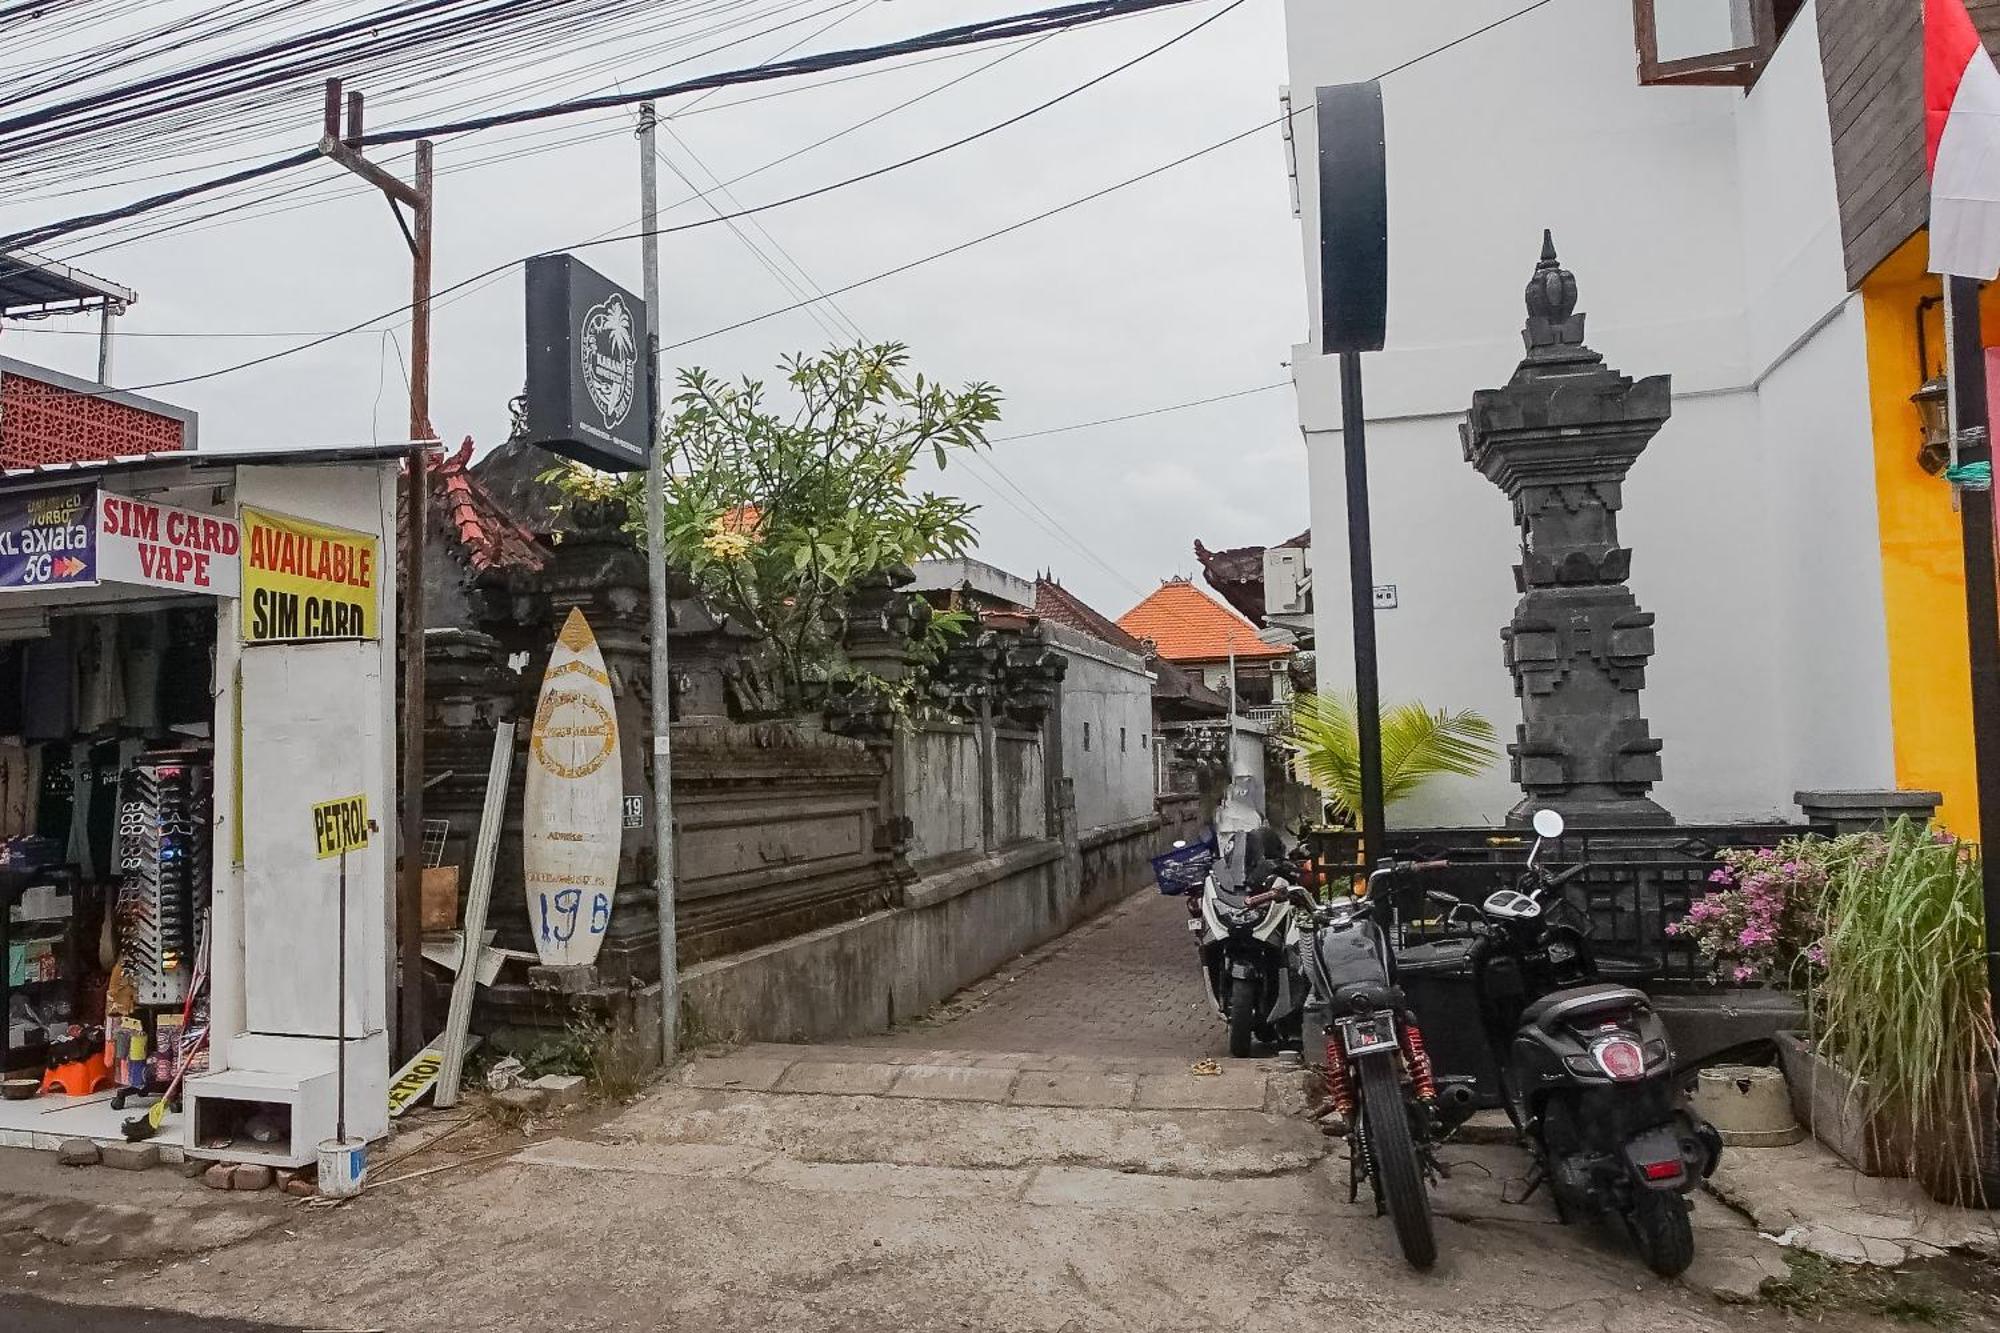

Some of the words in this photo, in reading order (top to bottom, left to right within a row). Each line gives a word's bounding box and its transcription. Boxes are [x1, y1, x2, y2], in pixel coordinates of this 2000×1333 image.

[21, 520, 87, 553] axiata
[103, 498, 159, 541] SIM
[166, 511, 239, 555] CARD
[23, 553, 52, 583] 5G
[138, 542, 210, 586] VAPE
[250, 525, 370, 588] AVAILABLE
[252, 587, 299, 639] SIM
[304, 596, 364, 637] CARD
[314, 798, 368, 853] PETROL
[624, 797, 641, 816] 19
